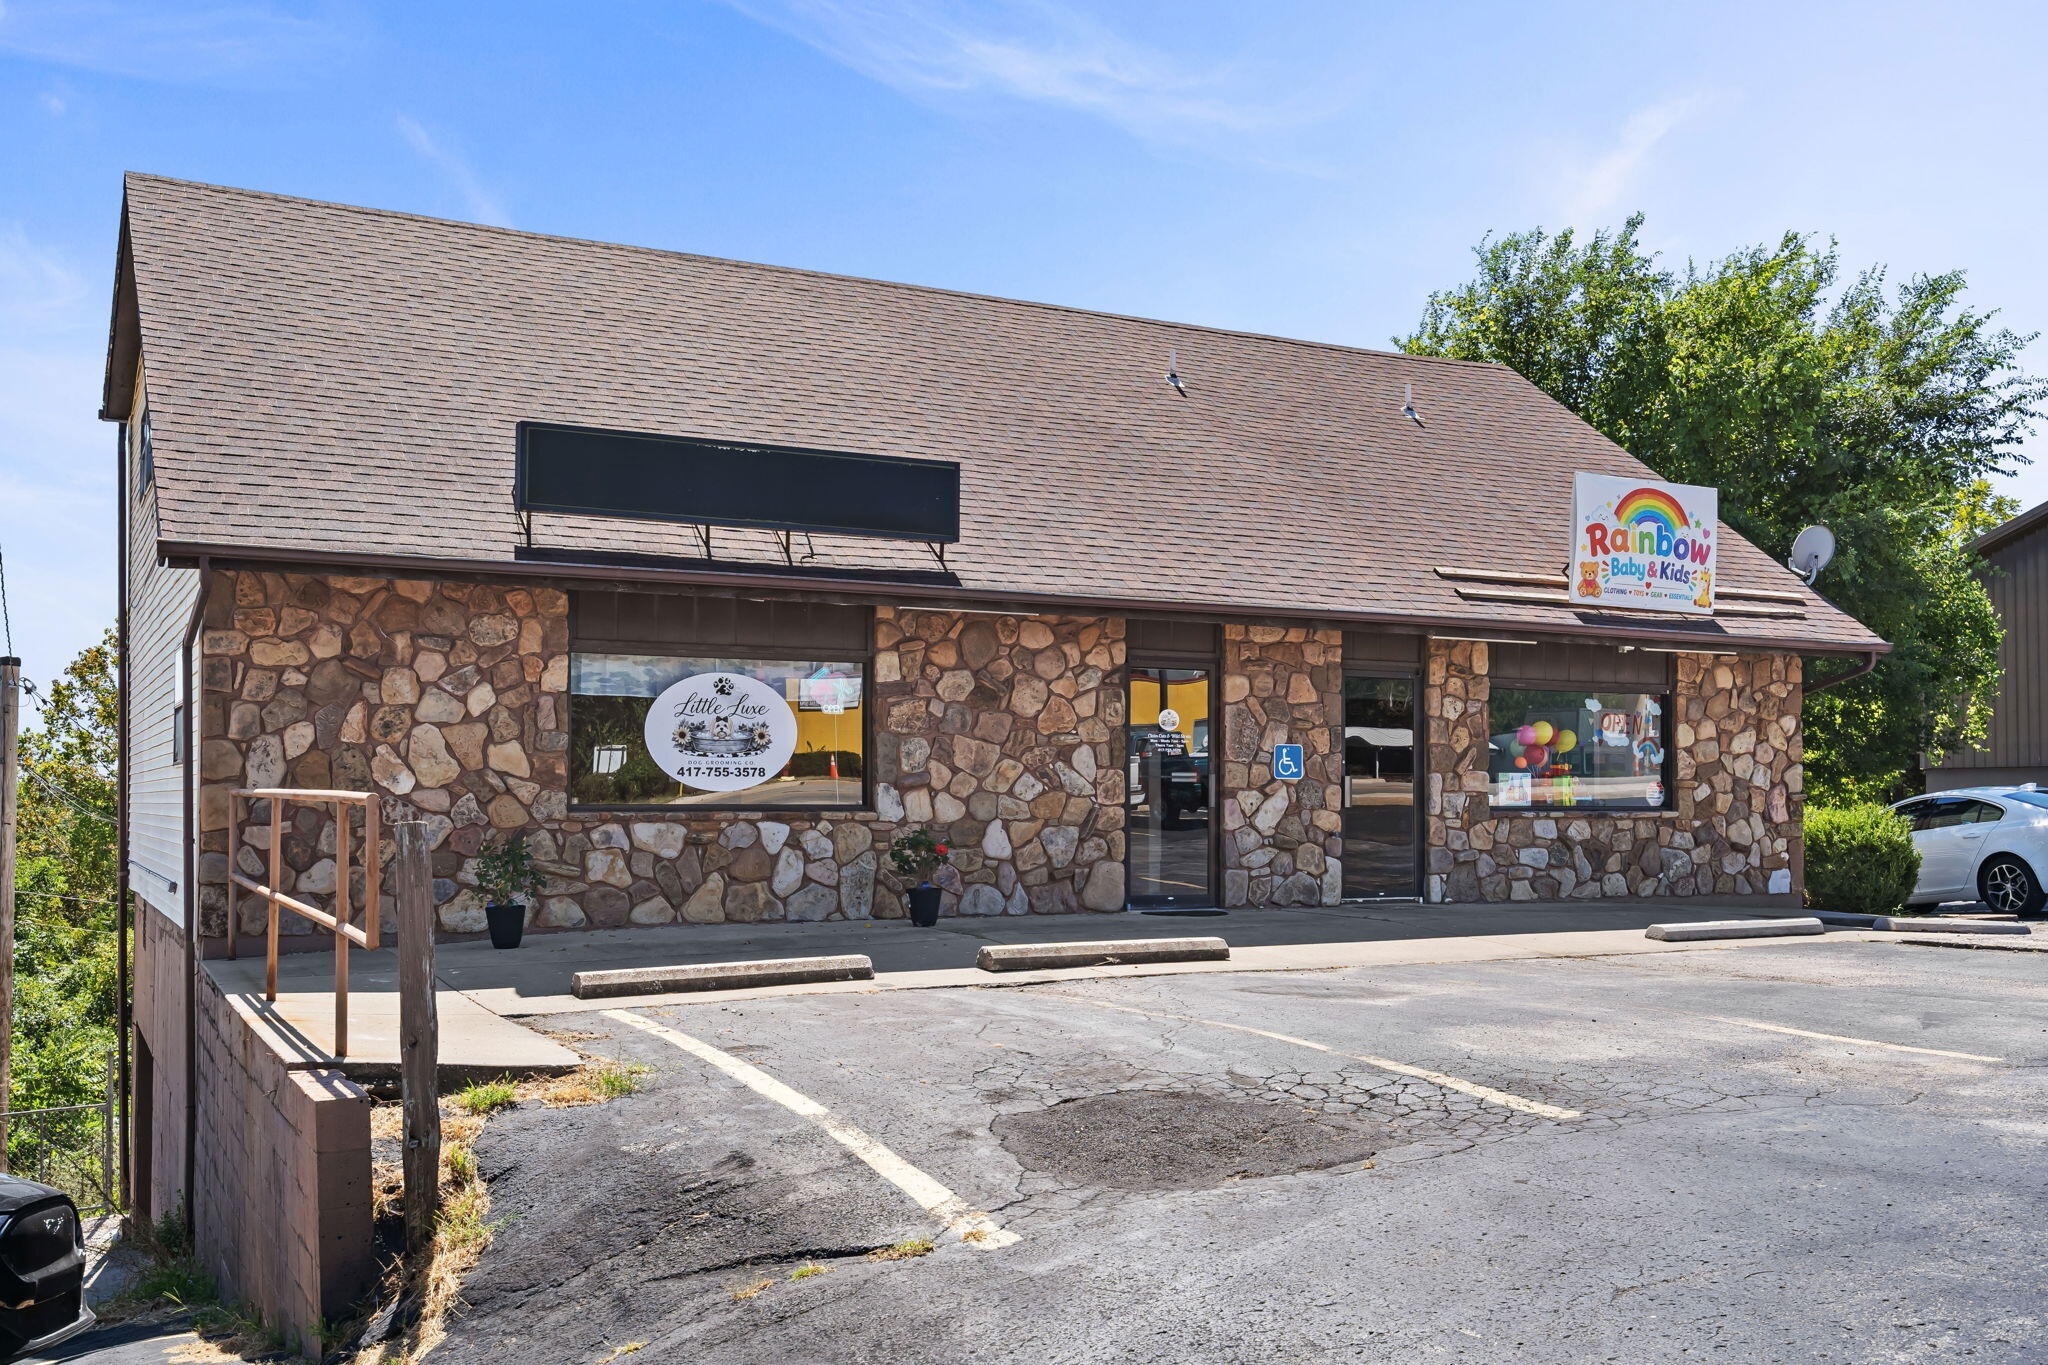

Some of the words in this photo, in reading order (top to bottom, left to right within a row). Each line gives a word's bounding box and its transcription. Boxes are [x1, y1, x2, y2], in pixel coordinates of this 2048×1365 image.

[1585, 522, 1711, 566] Rainbow
[1611, 557, 1645, 581] Baby
[1647, 560, 1658, 579] &
[1659, 560, 1691, 584] Kids
[1603, 587, 1627, 596] CLOTHING
[1633, 589, 1645, 597] TOYS
[1668, 593, 1693, 601] ESSENTIALS
[674, 692, 726, 717] Little
[727, 694, 770, 719] Luxe
[822, 704, 844, 713] OPEN
[1600, 713, 1643, 735] OPEN
[676, 766, 766, 778] 417-755-3578
